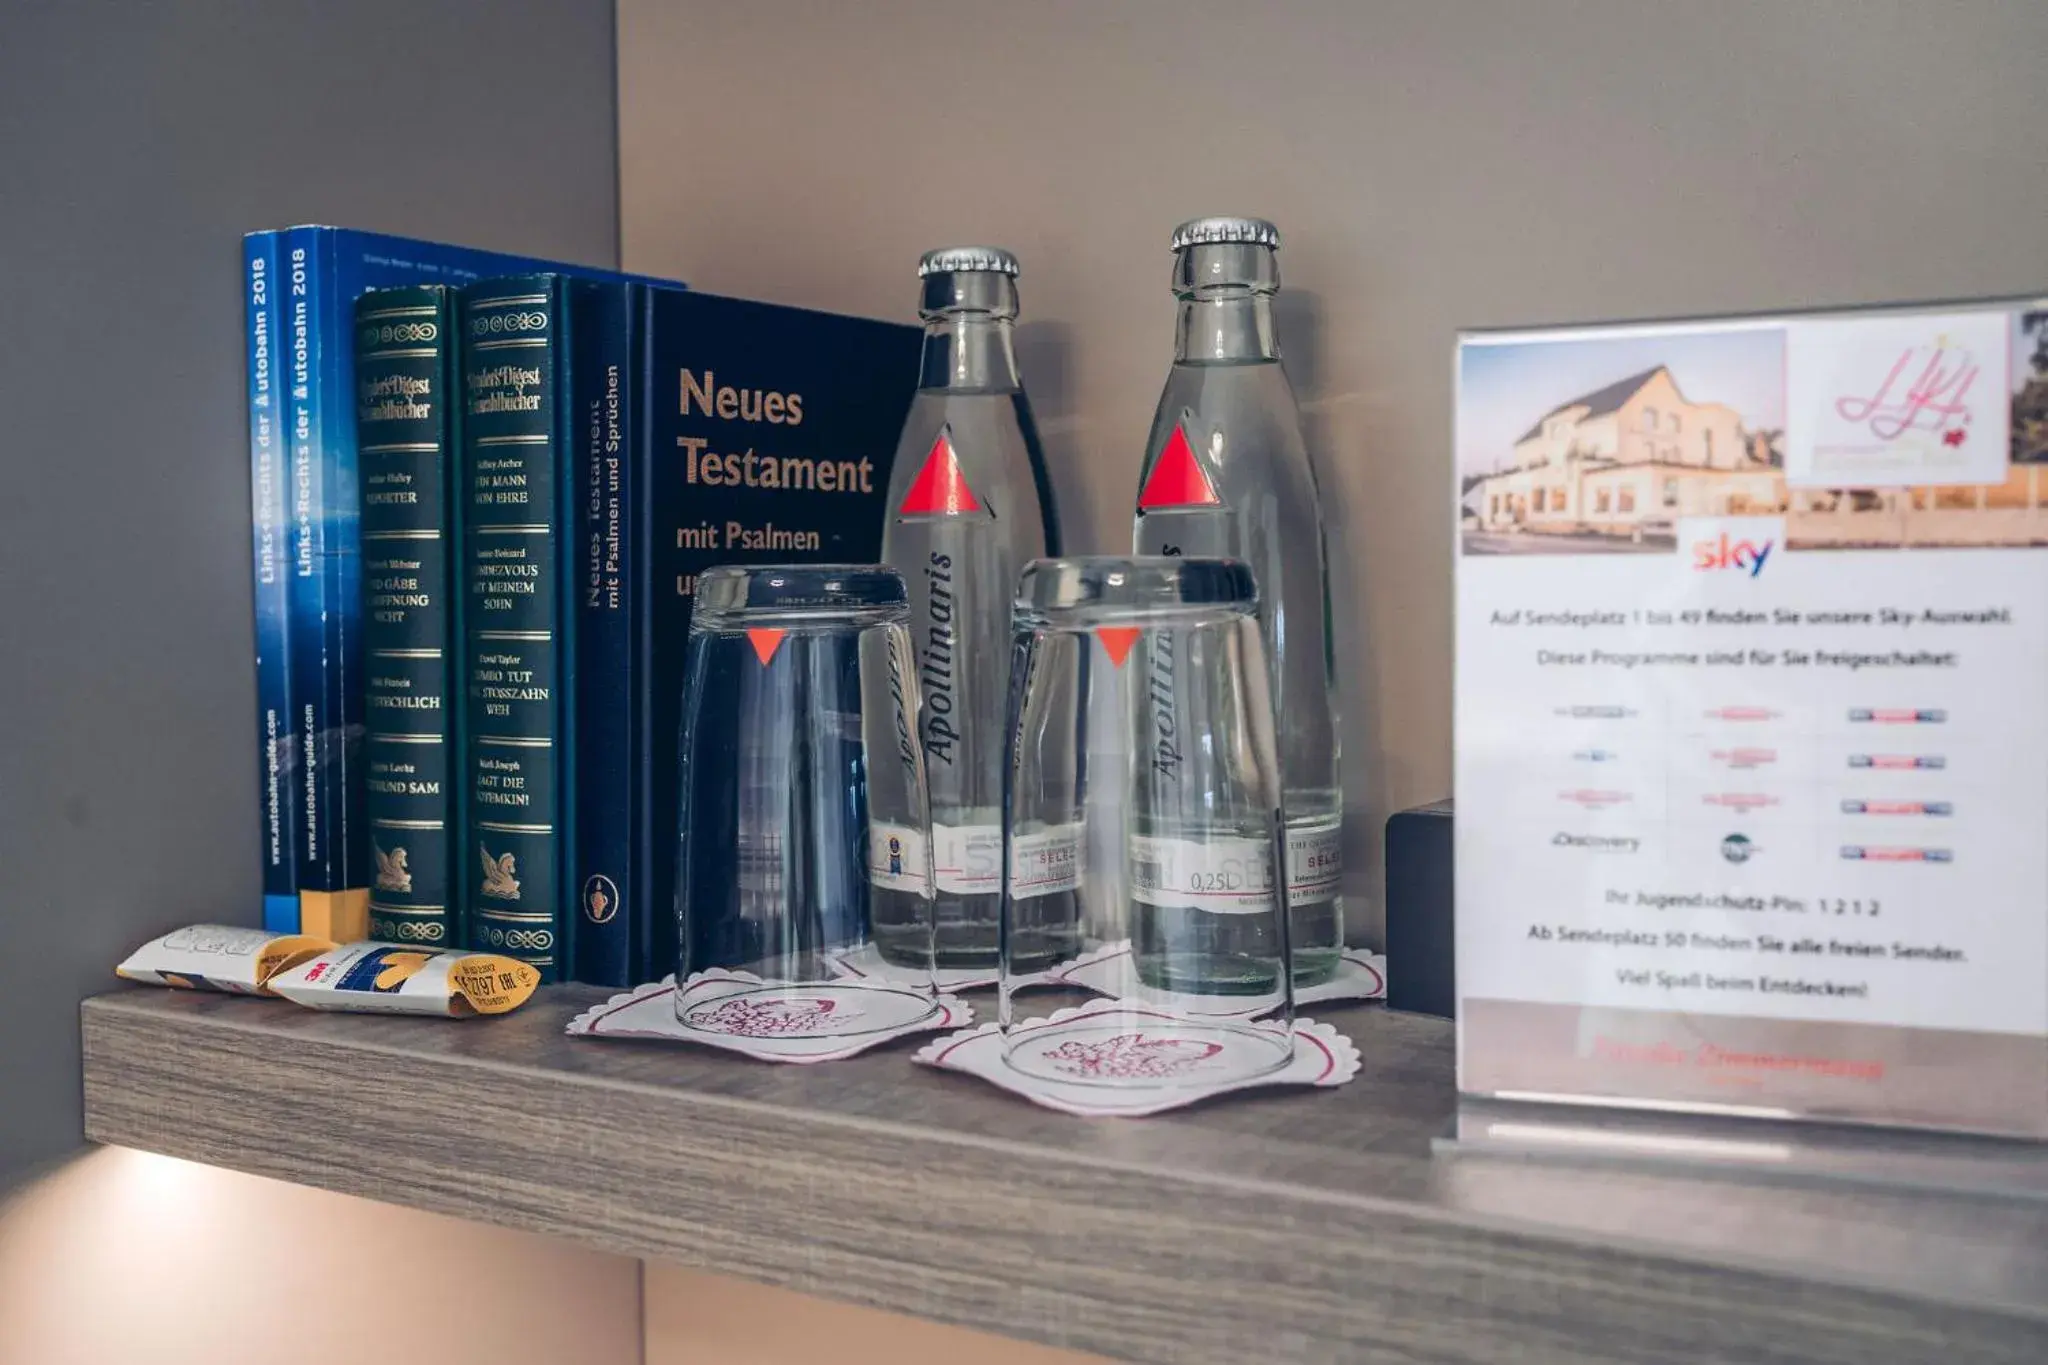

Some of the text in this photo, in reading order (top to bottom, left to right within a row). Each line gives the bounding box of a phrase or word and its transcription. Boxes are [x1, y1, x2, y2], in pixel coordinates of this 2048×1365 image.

[252, 257, 265, 304] 2018
[254, 312, 268, 407] Autobahn
[292, 247, 312, 577] Links+Rechts der Autobahn 2018
[680, 367, 803, 426] Neues
[258, 415, 270, 448] der
[587, 400, 601, 522] Testament
[676, 436, 874, 493] Testament
[492, 474, 528, 487] MANN
[605, 364, 622, 609] mit Psalmen und Sprüchen
[496, 492, 529, 504] EHRE
[676, 520, 820, 551] mit Psalmen
[1693, 532, 1774, 577] sky
[1490, 609, 1522, 625] Auf
[1525, 608, 1626, 628] Sendeplatz
[1646, 608, 1673, 625] bis
[1680, 608, 1701, 625] 49
[1706, 608, 1767, 625] finden
[1773, 608, 1800, 624] Sie
[1806, 610, 1872, 624] unsere
[923, 551, 960, 766] Apollinaris
[1537, 649, 1586, 665] Diese
[1592, 649, 1699, 669] Programme
[1706, 649, 1744, 665] sind
[1749, 649, 1776, 666] für
[1782, 650, 1810, 666] Sie
[507, 671, 533, 684] TUT
[267, 708, 280, 866] www.autobahn-guide.com
[304, 703, 317, 862] www.autobahn-guide.com
[408, 781, 440, 795] SAM
[503, 775, 525, 789] DIE
[1190, 871, 1235, 891] 0,25L
[1605, 888, 1630, 904] Ihr
[1819, 898, 1828, 913] 1
[1835, 898, 1847, 916] 2
[1853, 899, 1861, 914] 1
[1868, 899, 1881, 916] 2
[1527, 924, 1552, 941] Ab
[1557, 926, 1658, 947] Sendeplatz
[1665, 931, 1687, 947] 50
[1691, 930, 1752, 949] finden
[1757, 935, 1784, 952] Sie
[1790, 936, 1823, 954] alle
[1828, 938, 1887, 957] freien
[1616, 968, 1651, 986] Viel
[1706, 973, 1754, 992] beim
